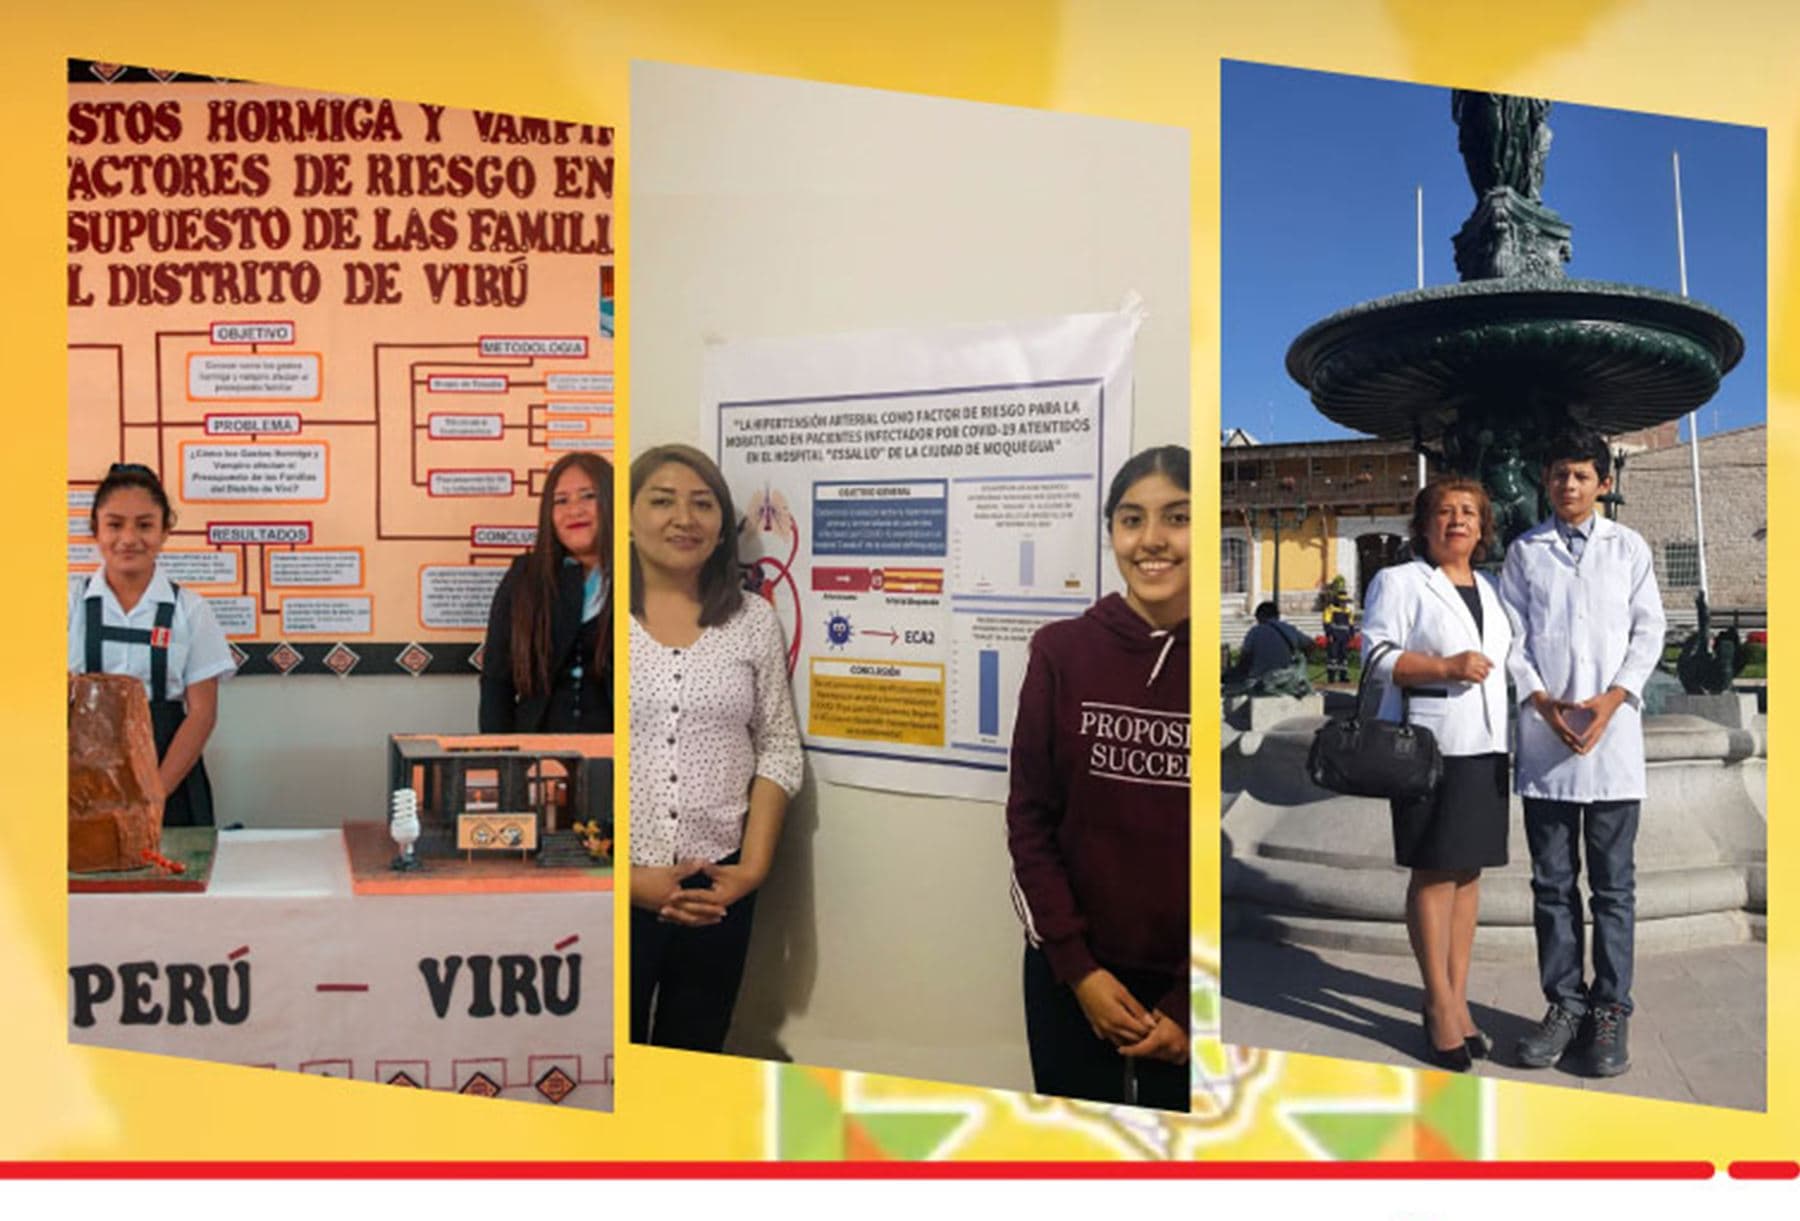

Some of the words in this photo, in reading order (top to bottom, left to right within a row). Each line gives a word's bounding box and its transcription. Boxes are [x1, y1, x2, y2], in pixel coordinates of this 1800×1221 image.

[68, 101, 182, 144] STOS
[207, 99, 402, 143] HORMIGA
[419, 103, 446, 142] Y
[68, 153, 270, 199] ACTORES
[293, 153, 352, 197] DE
[367, 153, 536, 198] RIESGO
[554, 156, 614, 199] EN
[68, 208, 291, 253] SUPUESTO
[302, 207, 361, 250] DE
[373, 207, 458, 251] LAS
[68, 264, 94, 306] L
[108, 260, 321, 306] DISTRITO
[343, 261, 402, 305] DE
[423, 256, 528, 307] VIRÚ
[218, 327, 288, 340] OBJETIVO
[213, 420, 293, 432] PROBLEMA
[753, 413, 827, 430] HIPERTENSIÓN
[829, 412, 878, 426] ARTERIAL
[881, 411, 914, 424] COMO
[916, 408, 960, 421] FACTOR
[963, 406, 978, 419] DE
[981, 403, 1025, 418] RIESGO
[1029, 402, 1061, 416] PARA
[1064, 401, 1080, 413] LA
[790, 433, 803, 445] EN
[806, 430, 862, 444] PACIENTES
[864, 427, 933, 442] INFECTADOR
[936, 426, 959, 439] POR
[962, 423, 1016, 438] COVID-19
[747, 451, 759, 463] EN
[762, 451, 771, 462] EL
[775, 449, 824, 462] HOSPITAL
[888, 447, 902, 459] DE
[905, 445, 918, 458] LA
[921, 443, 963, 457] CIUDAD
[966, 442, 979, 455] DE
[212, 528, 307, 541] RESULTADOS
[905, 631, 935, 644] ECA2
[68, 945, 250, 1028] PERÚ
[418, 934, 581, 1019] VIRÚ
